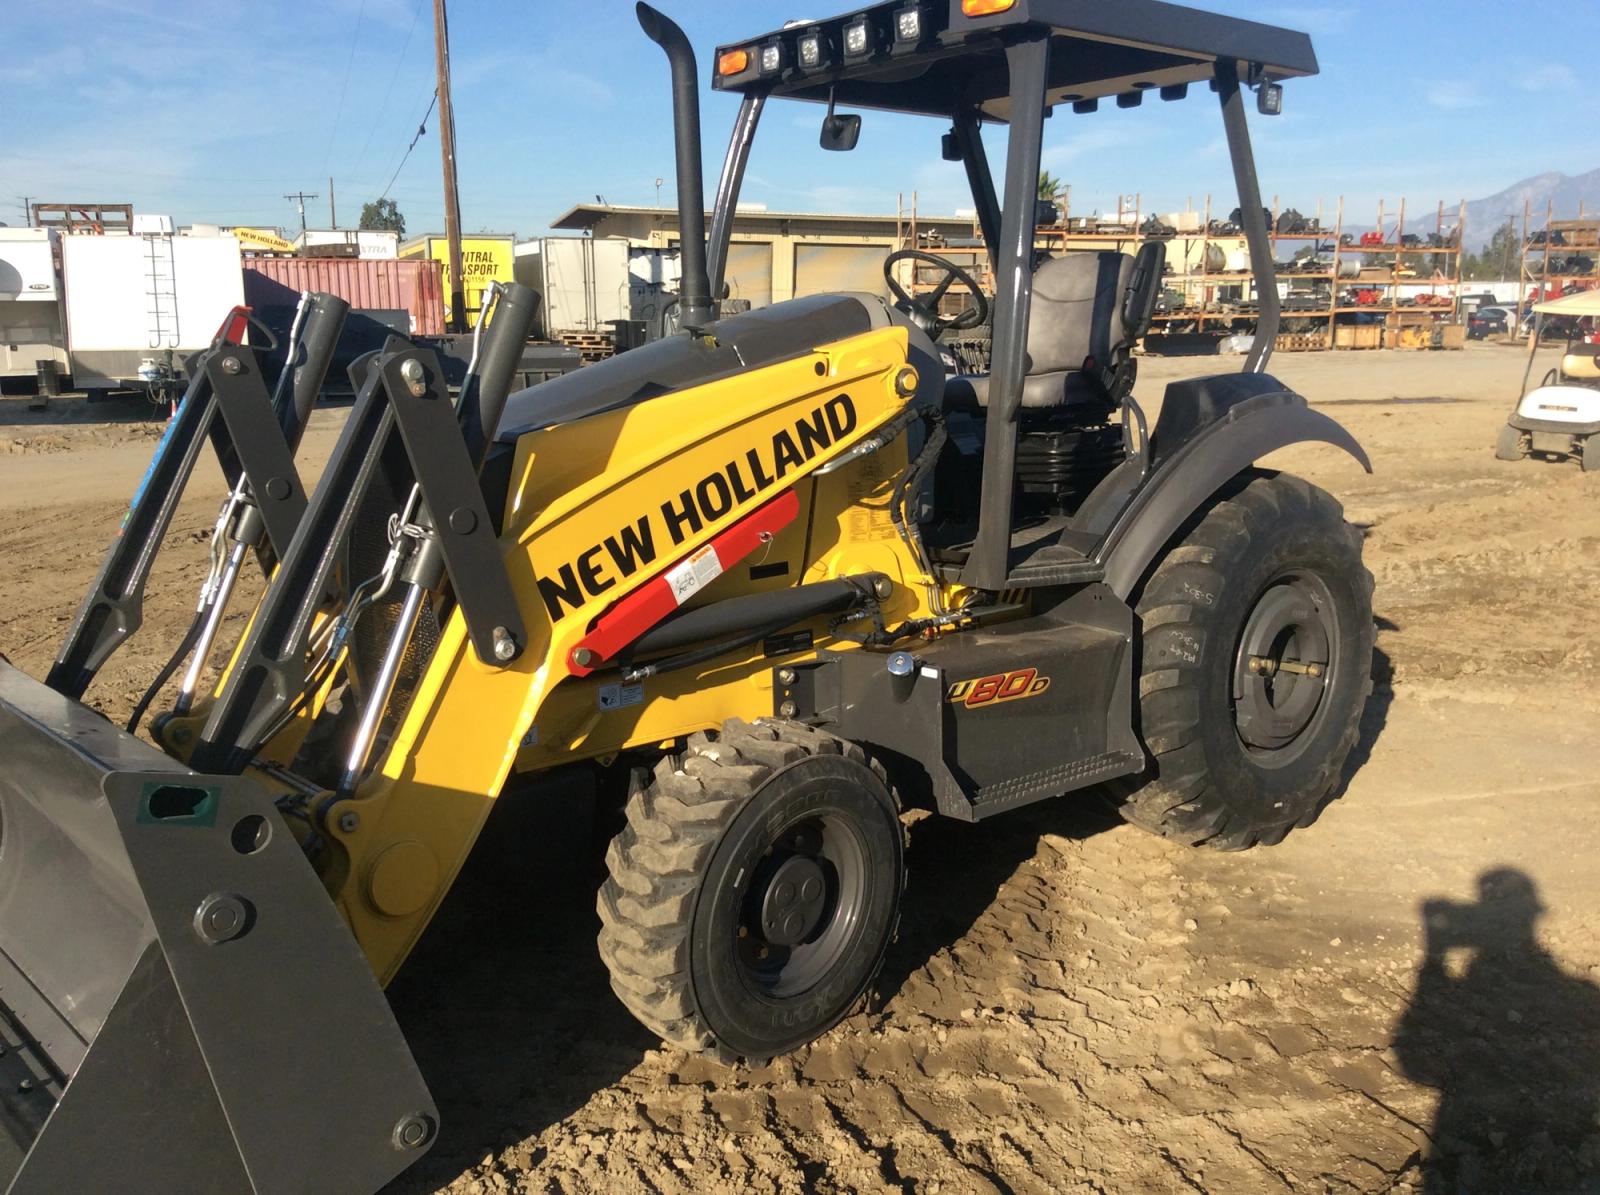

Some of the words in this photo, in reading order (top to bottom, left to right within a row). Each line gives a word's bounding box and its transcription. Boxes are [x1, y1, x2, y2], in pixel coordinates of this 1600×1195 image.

[241, 231, 256, 240] NEW
[257, 235, 288, 248] HOLLAND
[537, 516, 656, 622] NEW
[661, 394, 856, 545] HOLLAND
